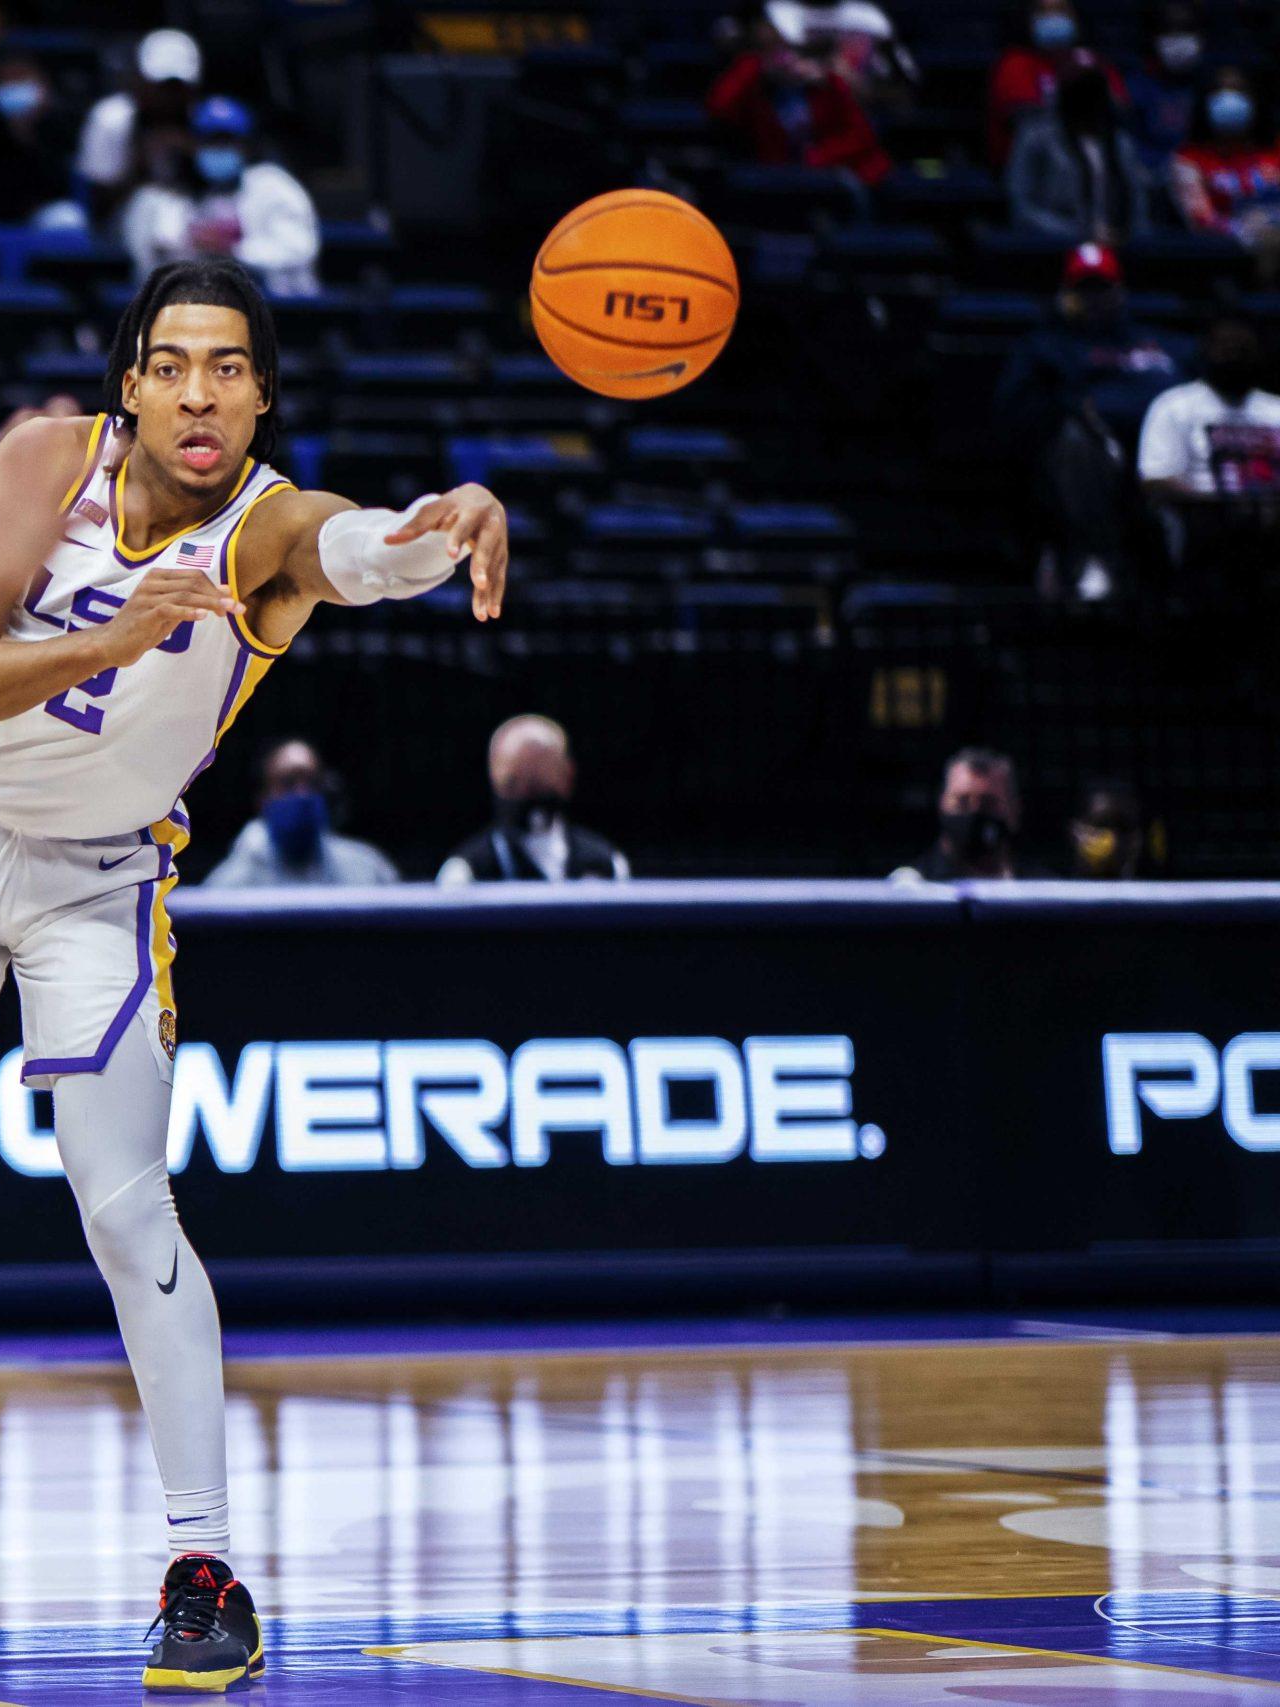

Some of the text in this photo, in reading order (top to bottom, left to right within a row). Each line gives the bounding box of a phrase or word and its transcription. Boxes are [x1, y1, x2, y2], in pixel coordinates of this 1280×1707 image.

[604, 291, 690, 324] LSU
[22, 563, 195, 654] LS
[43, 666, 118, 736] 2
